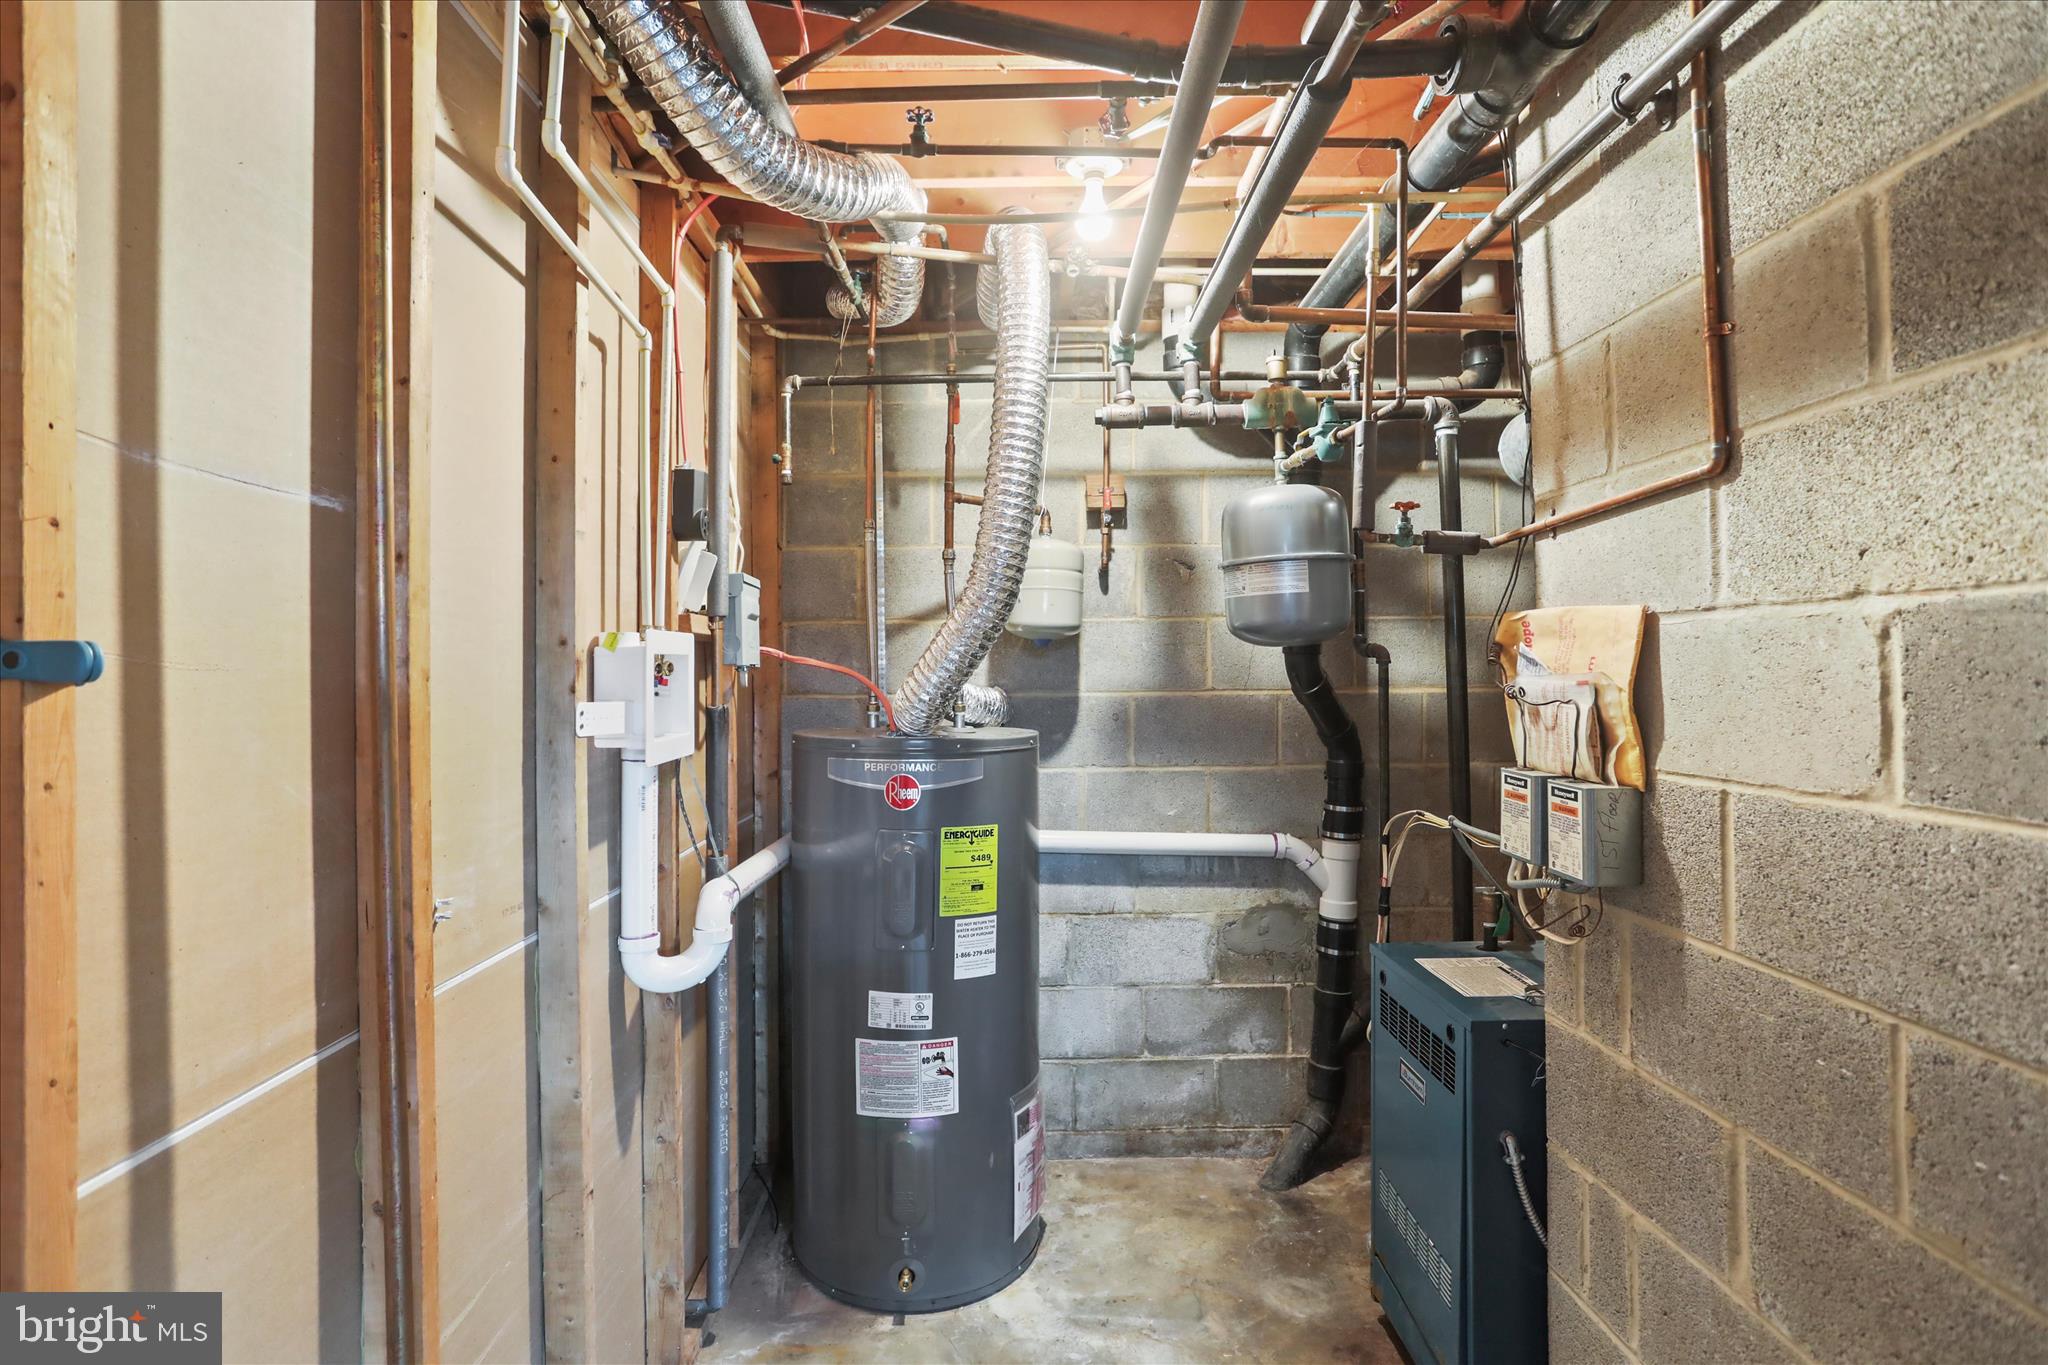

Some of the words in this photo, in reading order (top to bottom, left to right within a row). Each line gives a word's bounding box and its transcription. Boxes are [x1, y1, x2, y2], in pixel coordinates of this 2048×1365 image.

[864, 762, 944, 772] PERFORMANCE
[889, 775, 918, 805] Rheem
[1554, 789, 1575, 799] Honeywell
[971, 854, 991, 862] $489
